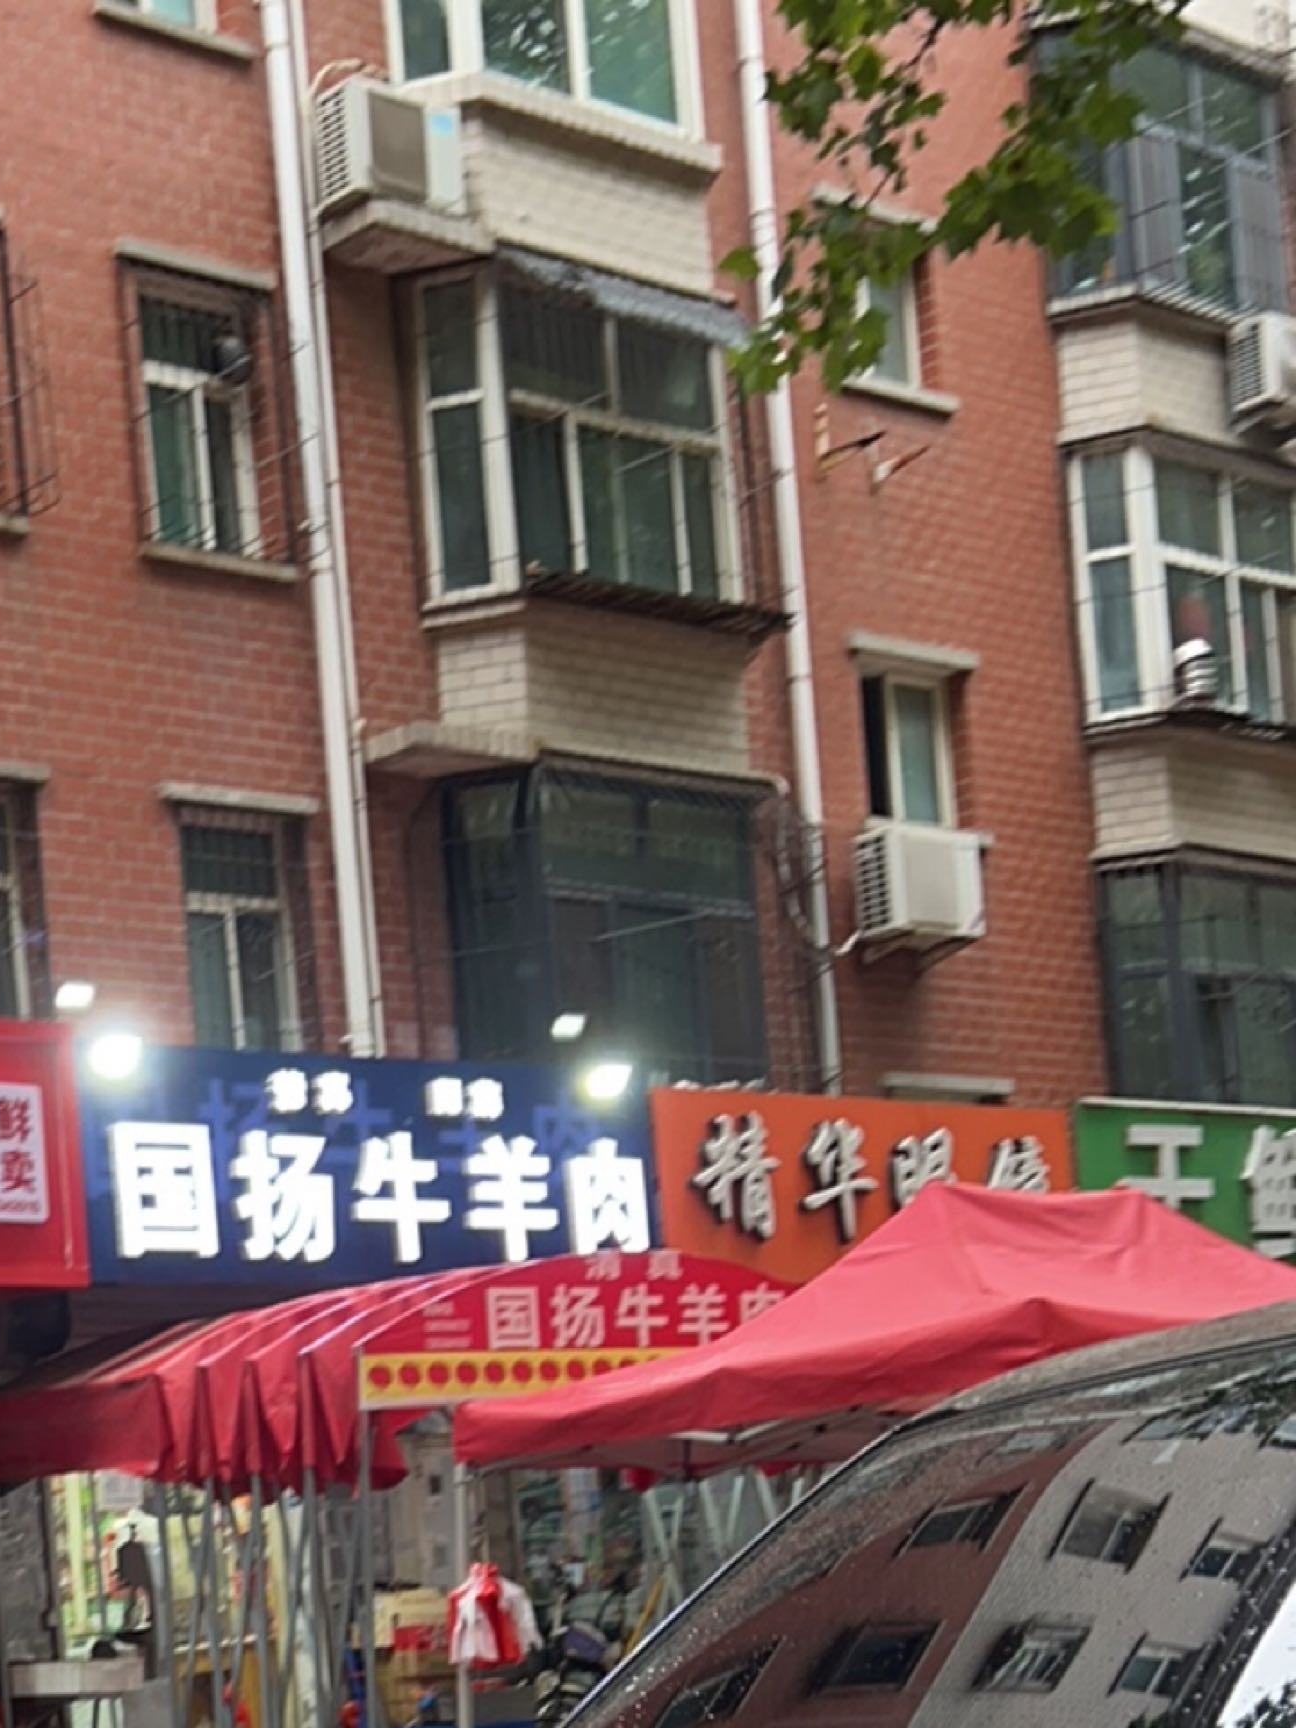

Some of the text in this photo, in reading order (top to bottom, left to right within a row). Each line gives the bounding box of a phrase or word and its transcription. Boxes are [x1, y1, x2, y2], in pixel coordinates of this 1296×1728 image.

[109, 1118, 652, 1262] 国扬牛羊肉
